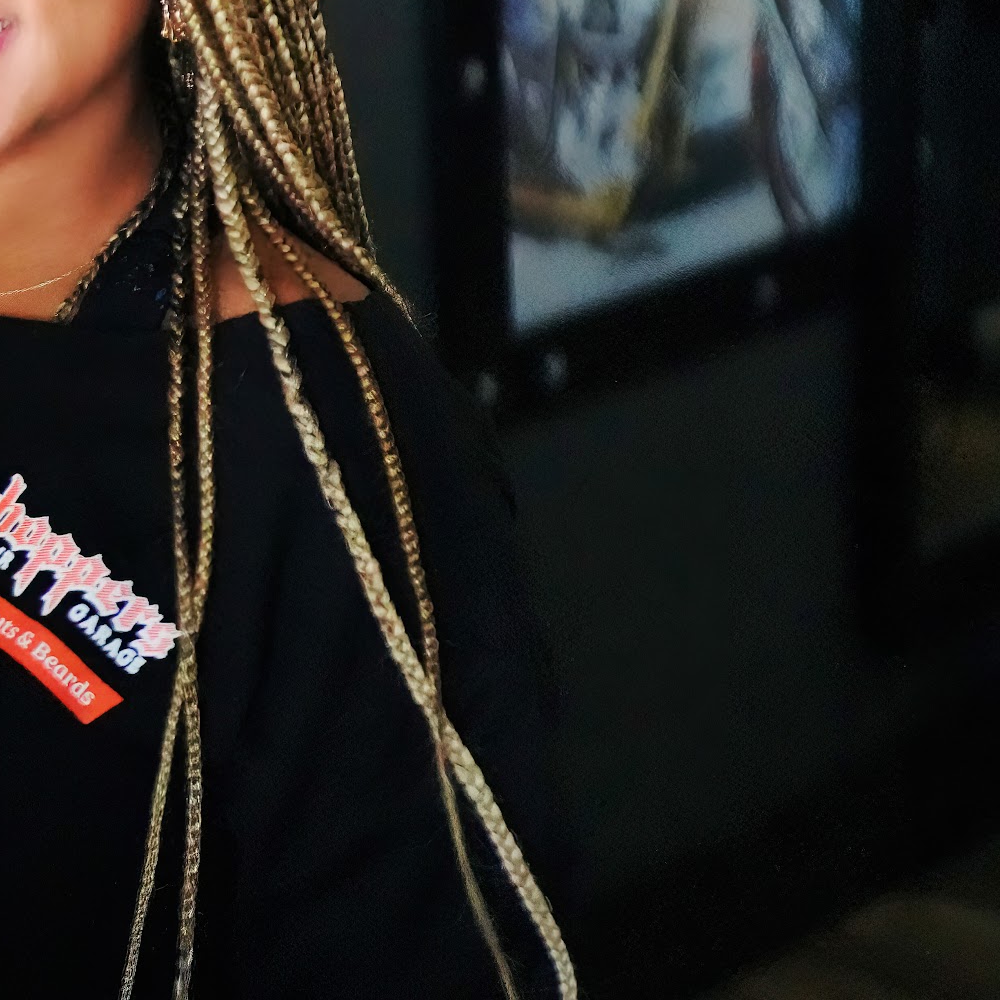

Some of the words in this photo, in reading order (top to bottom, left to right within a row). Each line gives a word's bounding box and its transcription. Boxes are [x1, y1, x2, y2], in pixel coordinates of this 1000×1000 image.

[17, 631, 36, 650] &
[30, 631, 96, 706] Beards
[67, 603, 147, 675] GARAGE
